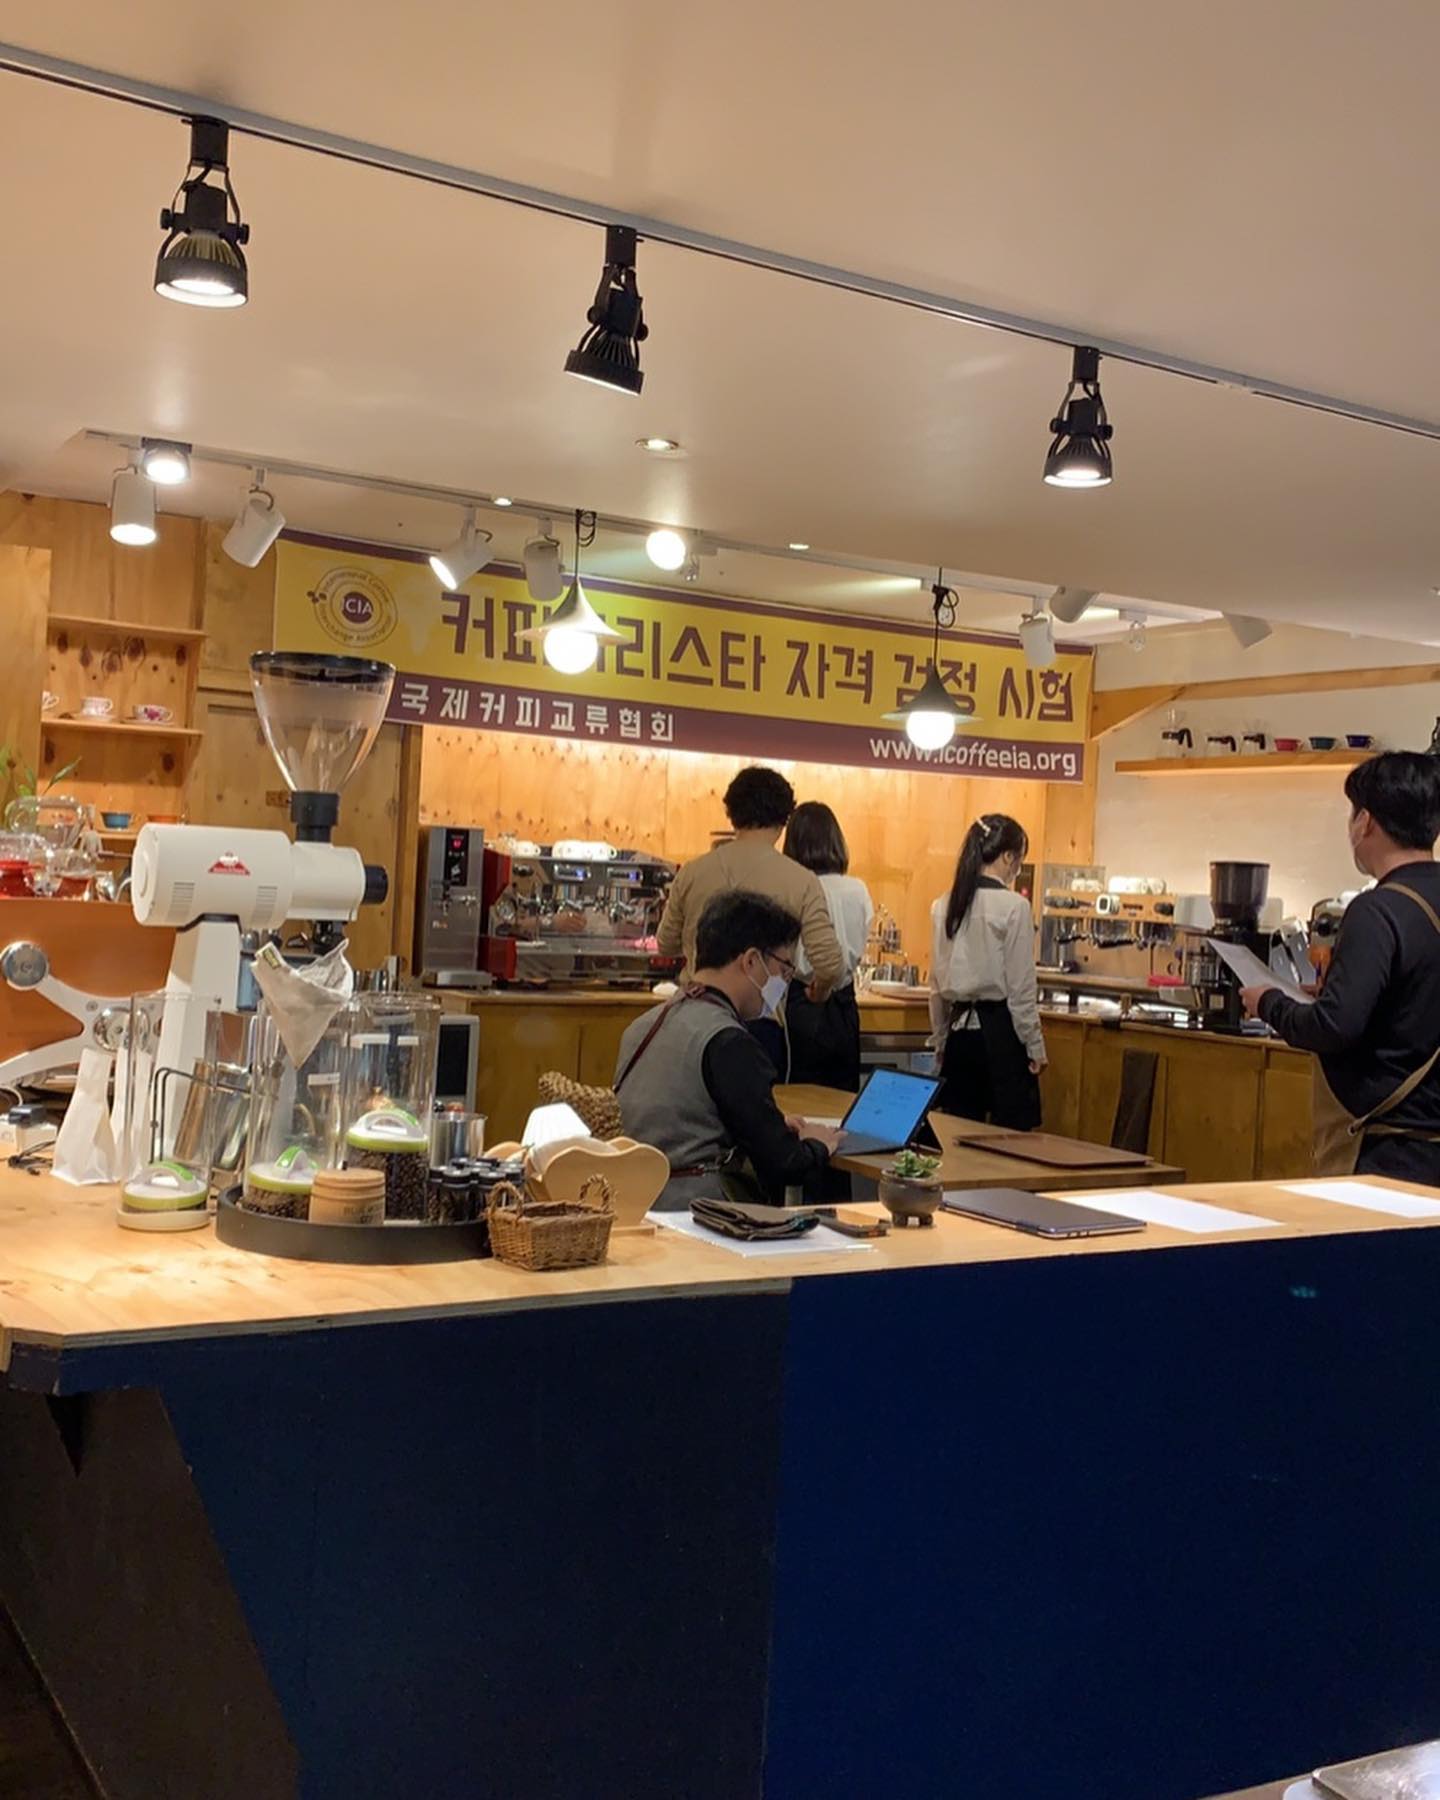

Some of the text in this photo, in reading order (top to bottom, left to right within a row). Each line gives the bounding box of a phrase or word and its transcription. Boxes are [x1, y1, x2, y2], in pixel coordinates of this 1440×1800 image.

[442, 592, 1074, 722] 커피리스타 자격 검정 시험
[870, 738, 1077, 777] www.icoffeeia.org
